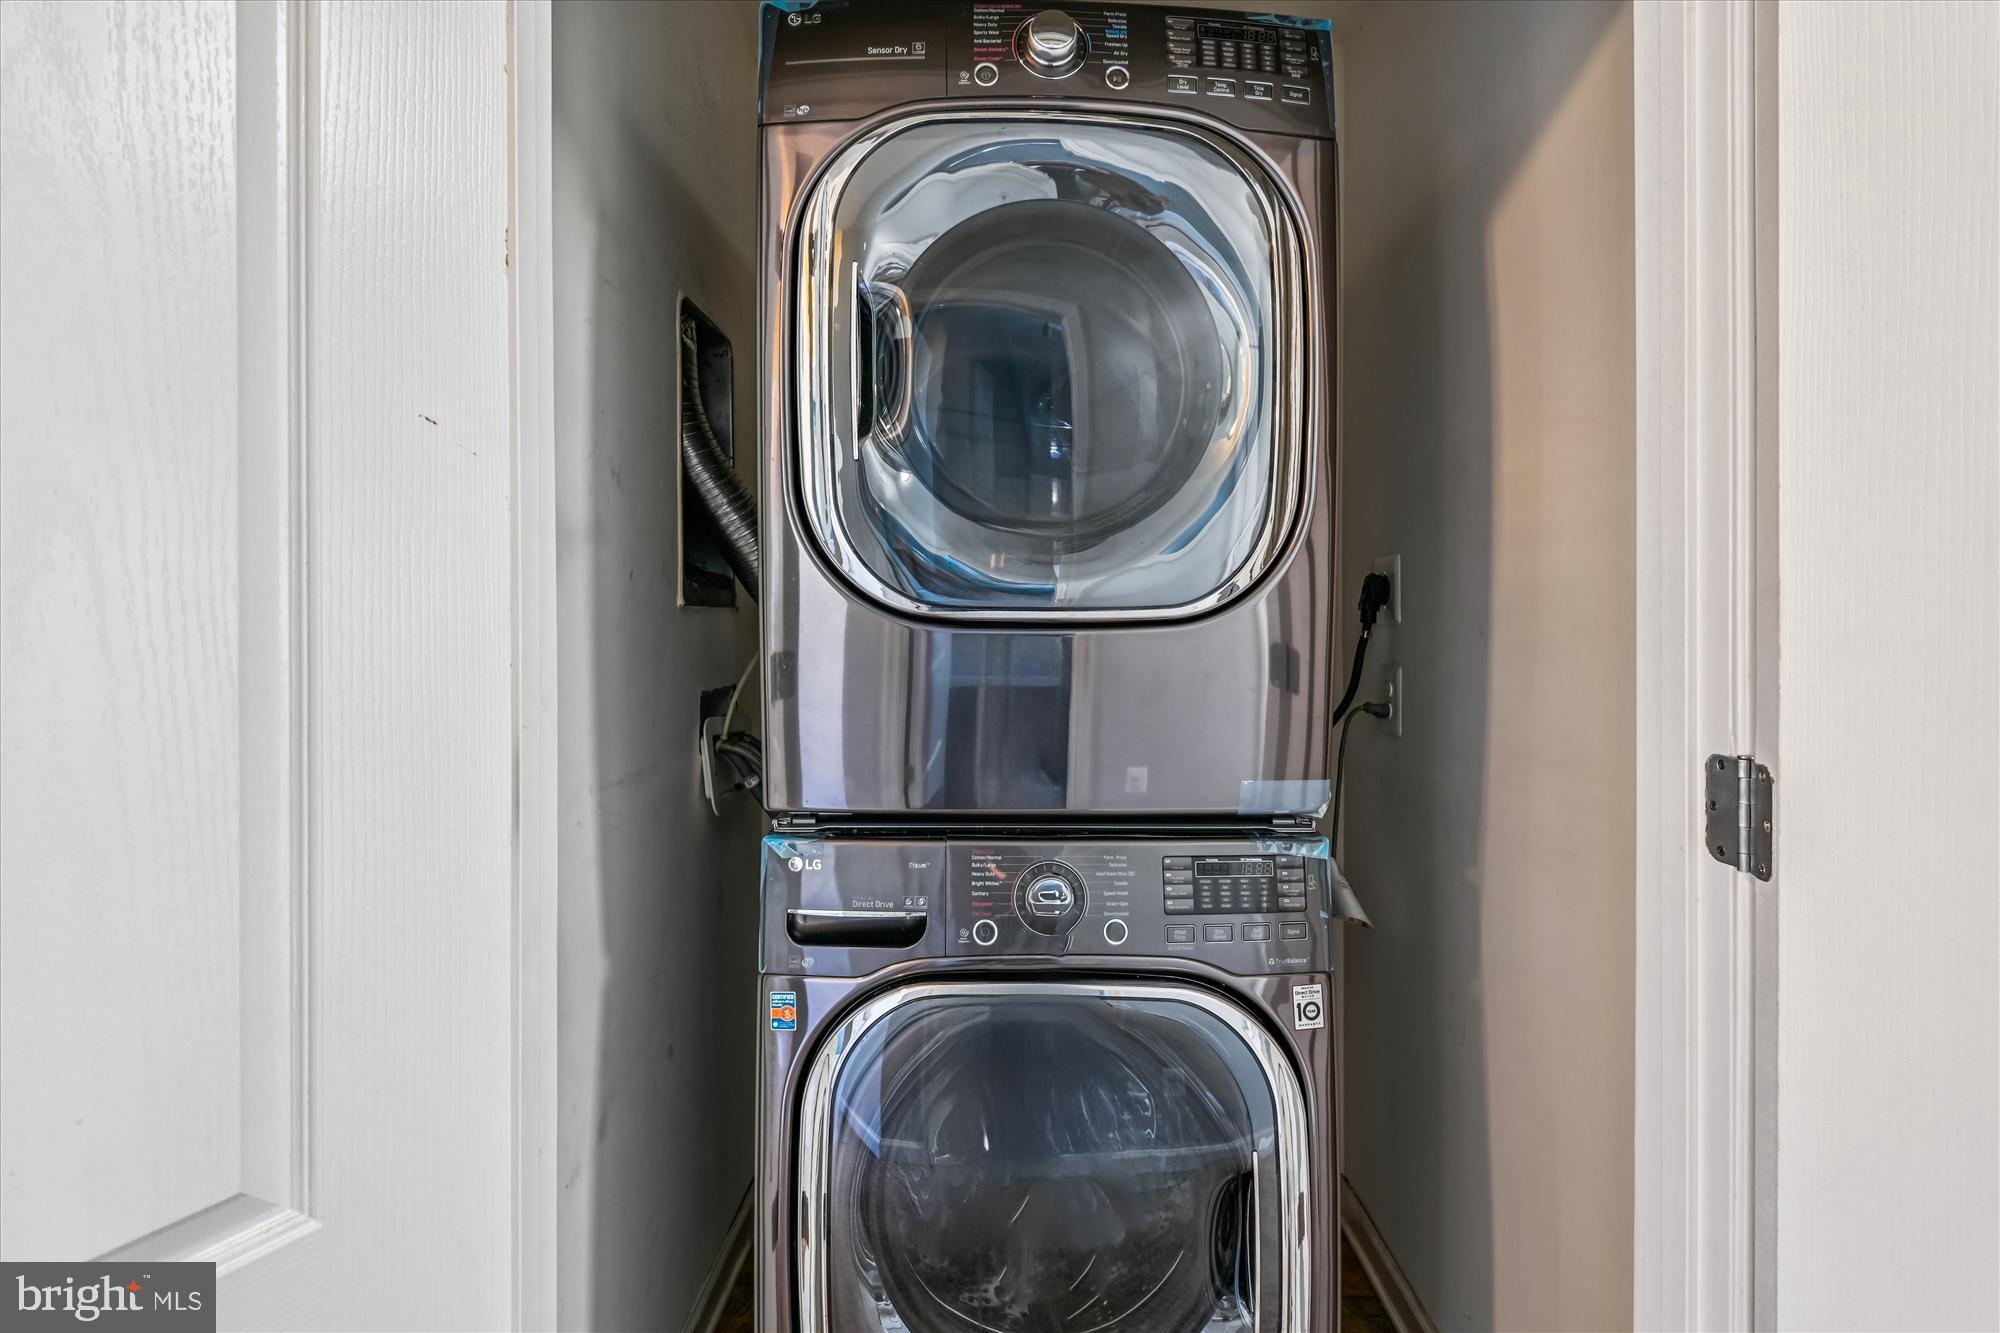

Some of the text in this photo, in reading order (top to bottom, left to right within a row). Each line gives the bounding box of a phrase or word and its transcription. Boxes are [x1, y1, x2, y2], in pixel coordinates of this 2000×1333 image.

[804, 13, 821, 24] LG
[867, 46, 908, 56] Sensor Dry
[1178, 78, 1187, 86] Dry
[805, 859, 822, 870] LG
[852, 900, 874, 909] Direct
[875, 900, 894, 909] Drive
[1296, 1001, 1321, 1022] 10
